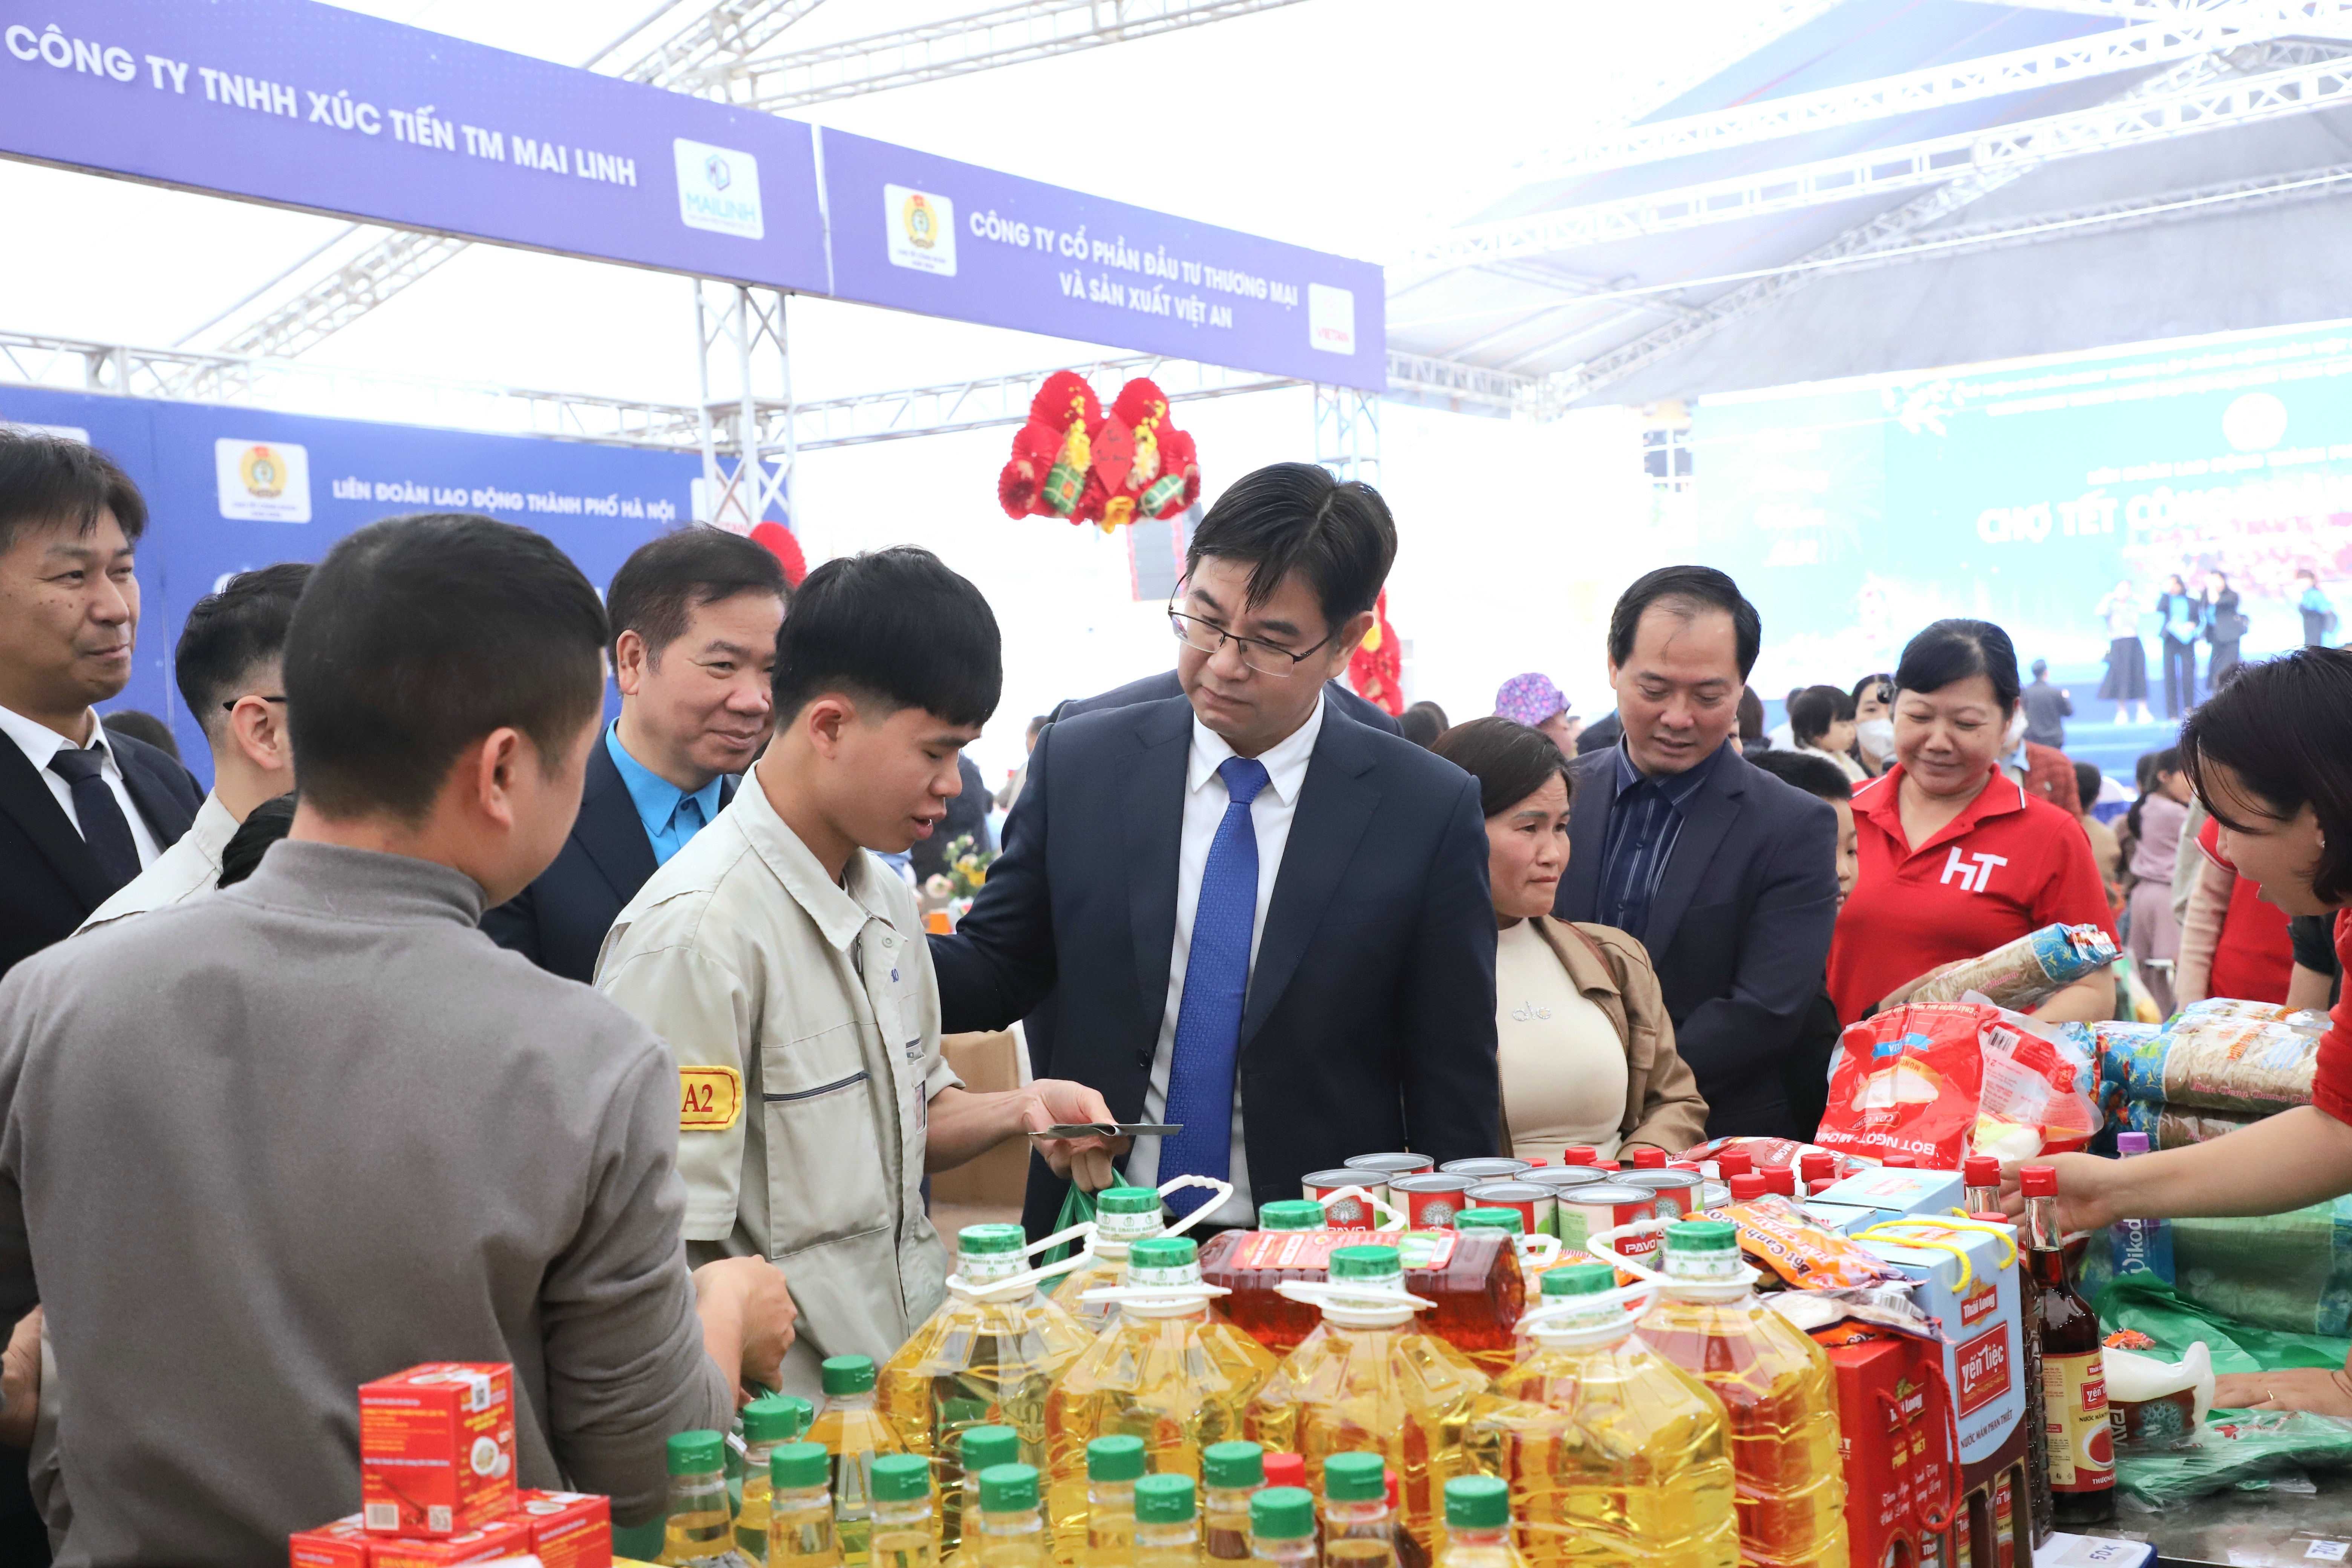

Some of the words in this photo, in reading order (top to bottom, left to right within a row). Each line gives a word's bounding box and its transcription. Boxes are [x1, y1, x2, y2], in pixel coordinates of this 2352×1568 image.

[5, 23, 137, 82] CÔNG
[145, 54, 189, 94] TY
[199, 66, 297, 118] TNHH
[306, 90, 382, 136] XÚC
[388, 105, 455, 151] TIẾN
[461, 124, 504, 161] TM
[512, 136, 567, 174] MAI
[575, 149, 637, 187] LINH
[969, 209, 1031, 247] CÔNG
[1033, 226, 1055, 253] TY
[1059, 225, 1089, 260] CỔ
[1181, 260, 1202, 286] TƯ
[1204, 266, 1268, 300] THƯƠNG
[1270, 281, 1298, 311] MẠI
[1059, 268, 1087, 299] VÀ
[1088, 273, 1125, 307] SẢN
[1128, 283, 1171, 316] XUẤT
[1174, 295, 1206, 329] VIỆT
[1209, 304, 1233, 329] AN
[332, 476, 372, 500] LIÊN
[375, 480, 429, 505] ĐOÀN
[432, 487, 469, 507] LAO
[471, 486, 524, 513] ĐỘNG
[526, 491, 582, 514] THÀNH
[585, 493, 619, 518] PHỐ
[621, 496, 645, 519] HÀ
[647, 499, 675, 524] NỘI
[1977, 501, 2052, 543] CHỢ
[2057, 488, 2118, 536] TẾT
[682, 1084, 713, 1112] A2
[1814, 1133, 1838, 1144] CHÍN
[1900, 1139, 1936, 1156] BỘT
[1770, 1149, 1787, 1163] CHÍNH
[1625, 1239, 1656, 1254] PAVO
[1748, 1229, 1784, 1256] Canh
[2122, 1219, 2145, 1274] Vikod
[1784, 1251, 1811, 1278] Bột
[1963, 1300, 1979, 1318] Thái
[1979, 1293, 1995, 1309] Long
[1977, 1343, 2004, 1373] Tiệc
[2110, 1409, 2128, 1447] PAV
[2089, 1545, 2121, 1560] 50K
